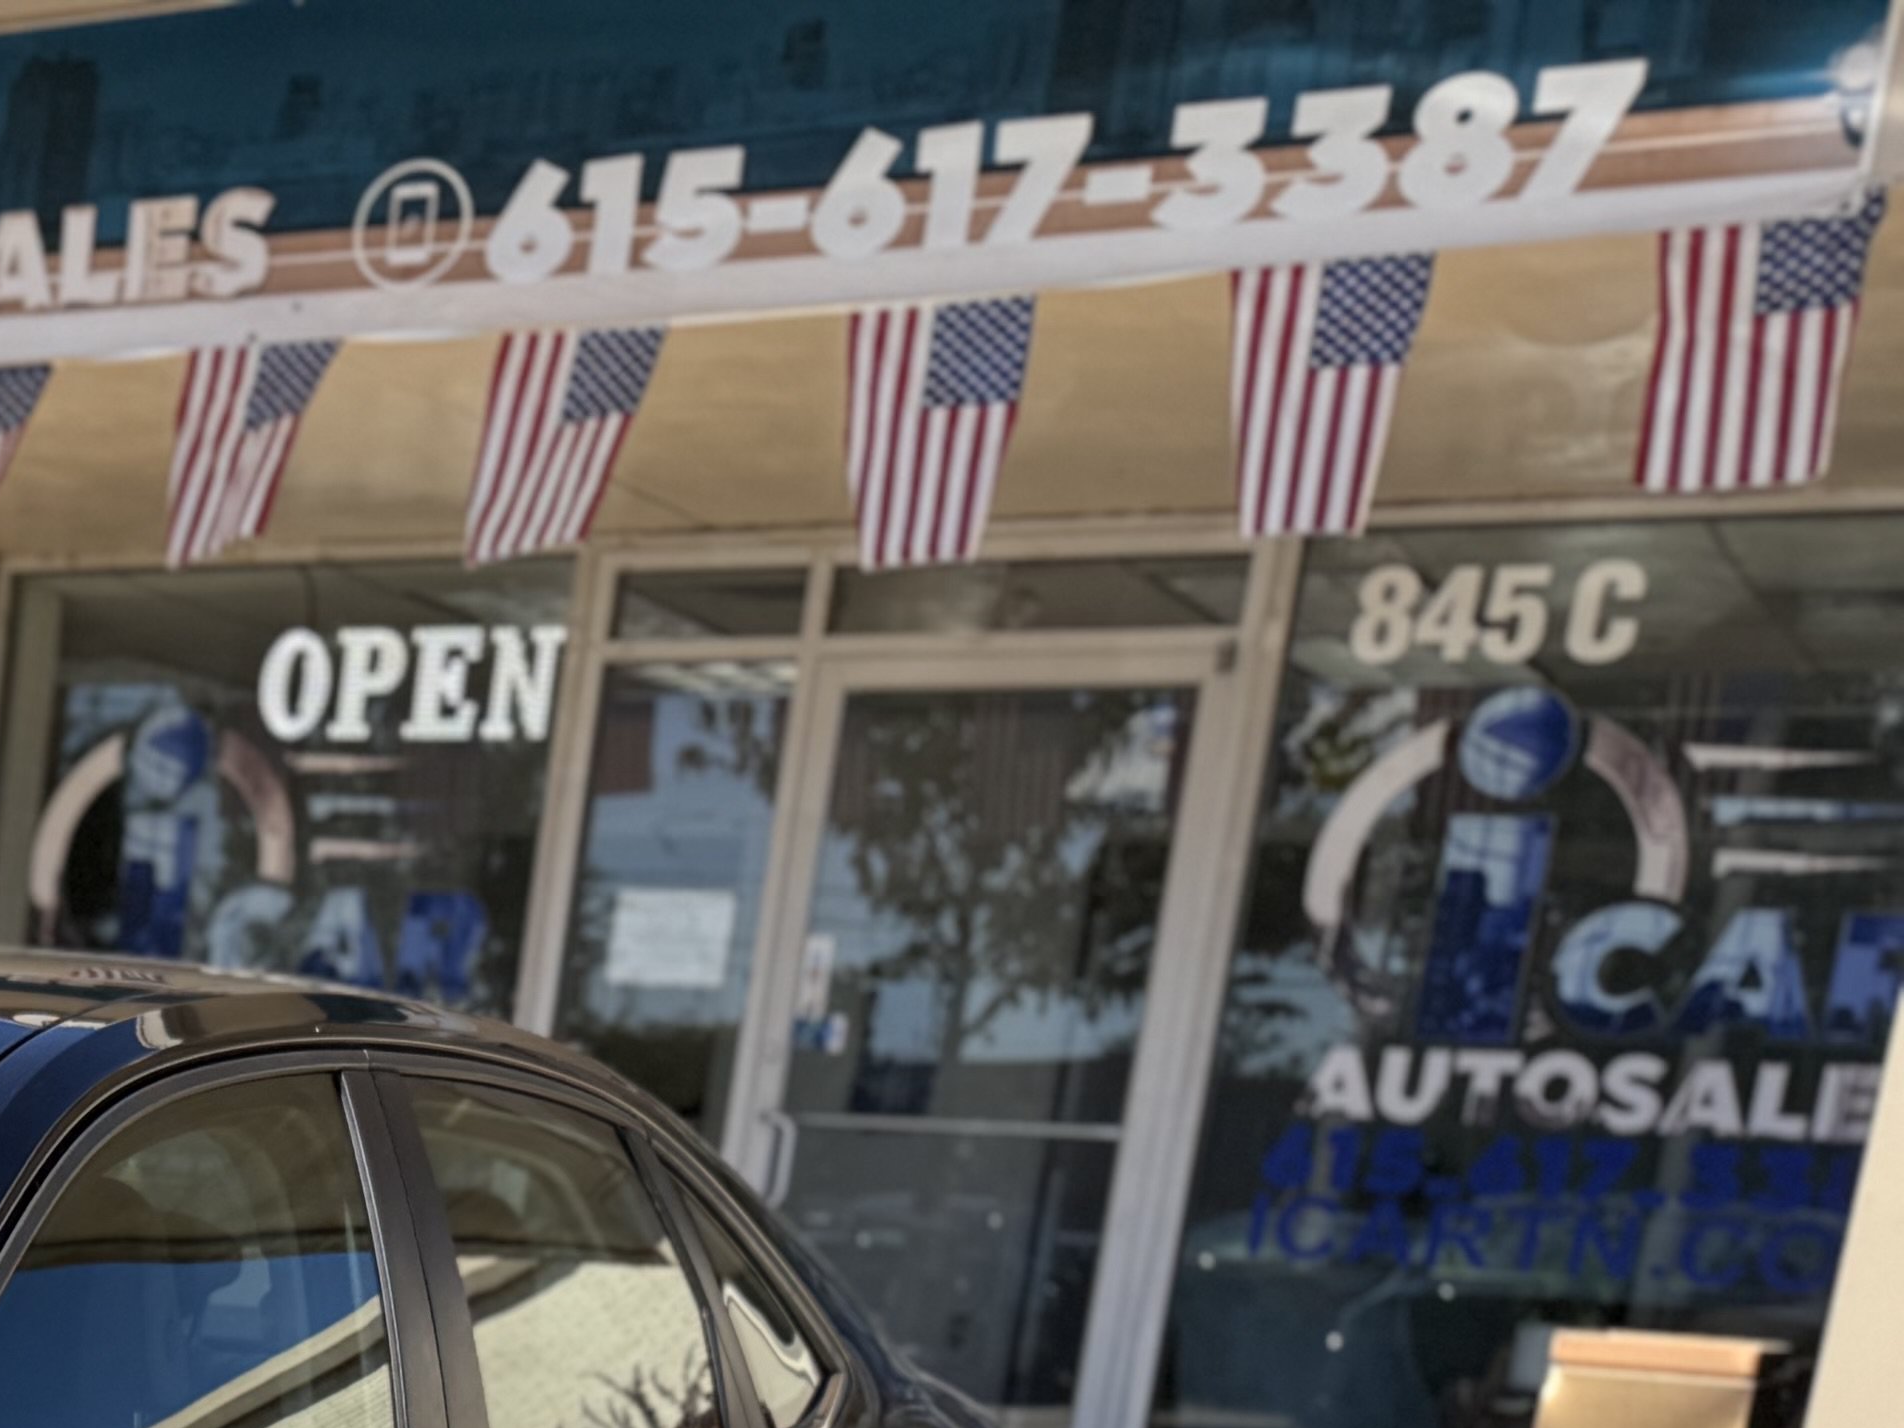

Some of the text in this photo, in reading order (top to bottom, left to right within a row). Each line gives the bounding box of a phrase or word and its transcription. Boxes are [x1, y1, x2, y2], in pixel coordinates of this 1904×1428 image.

[484, 59, 1648, 283] 615-617-3387
[1350, 559, 1647, 665] 845 C
[257, 624, 567, 742] OPEN
